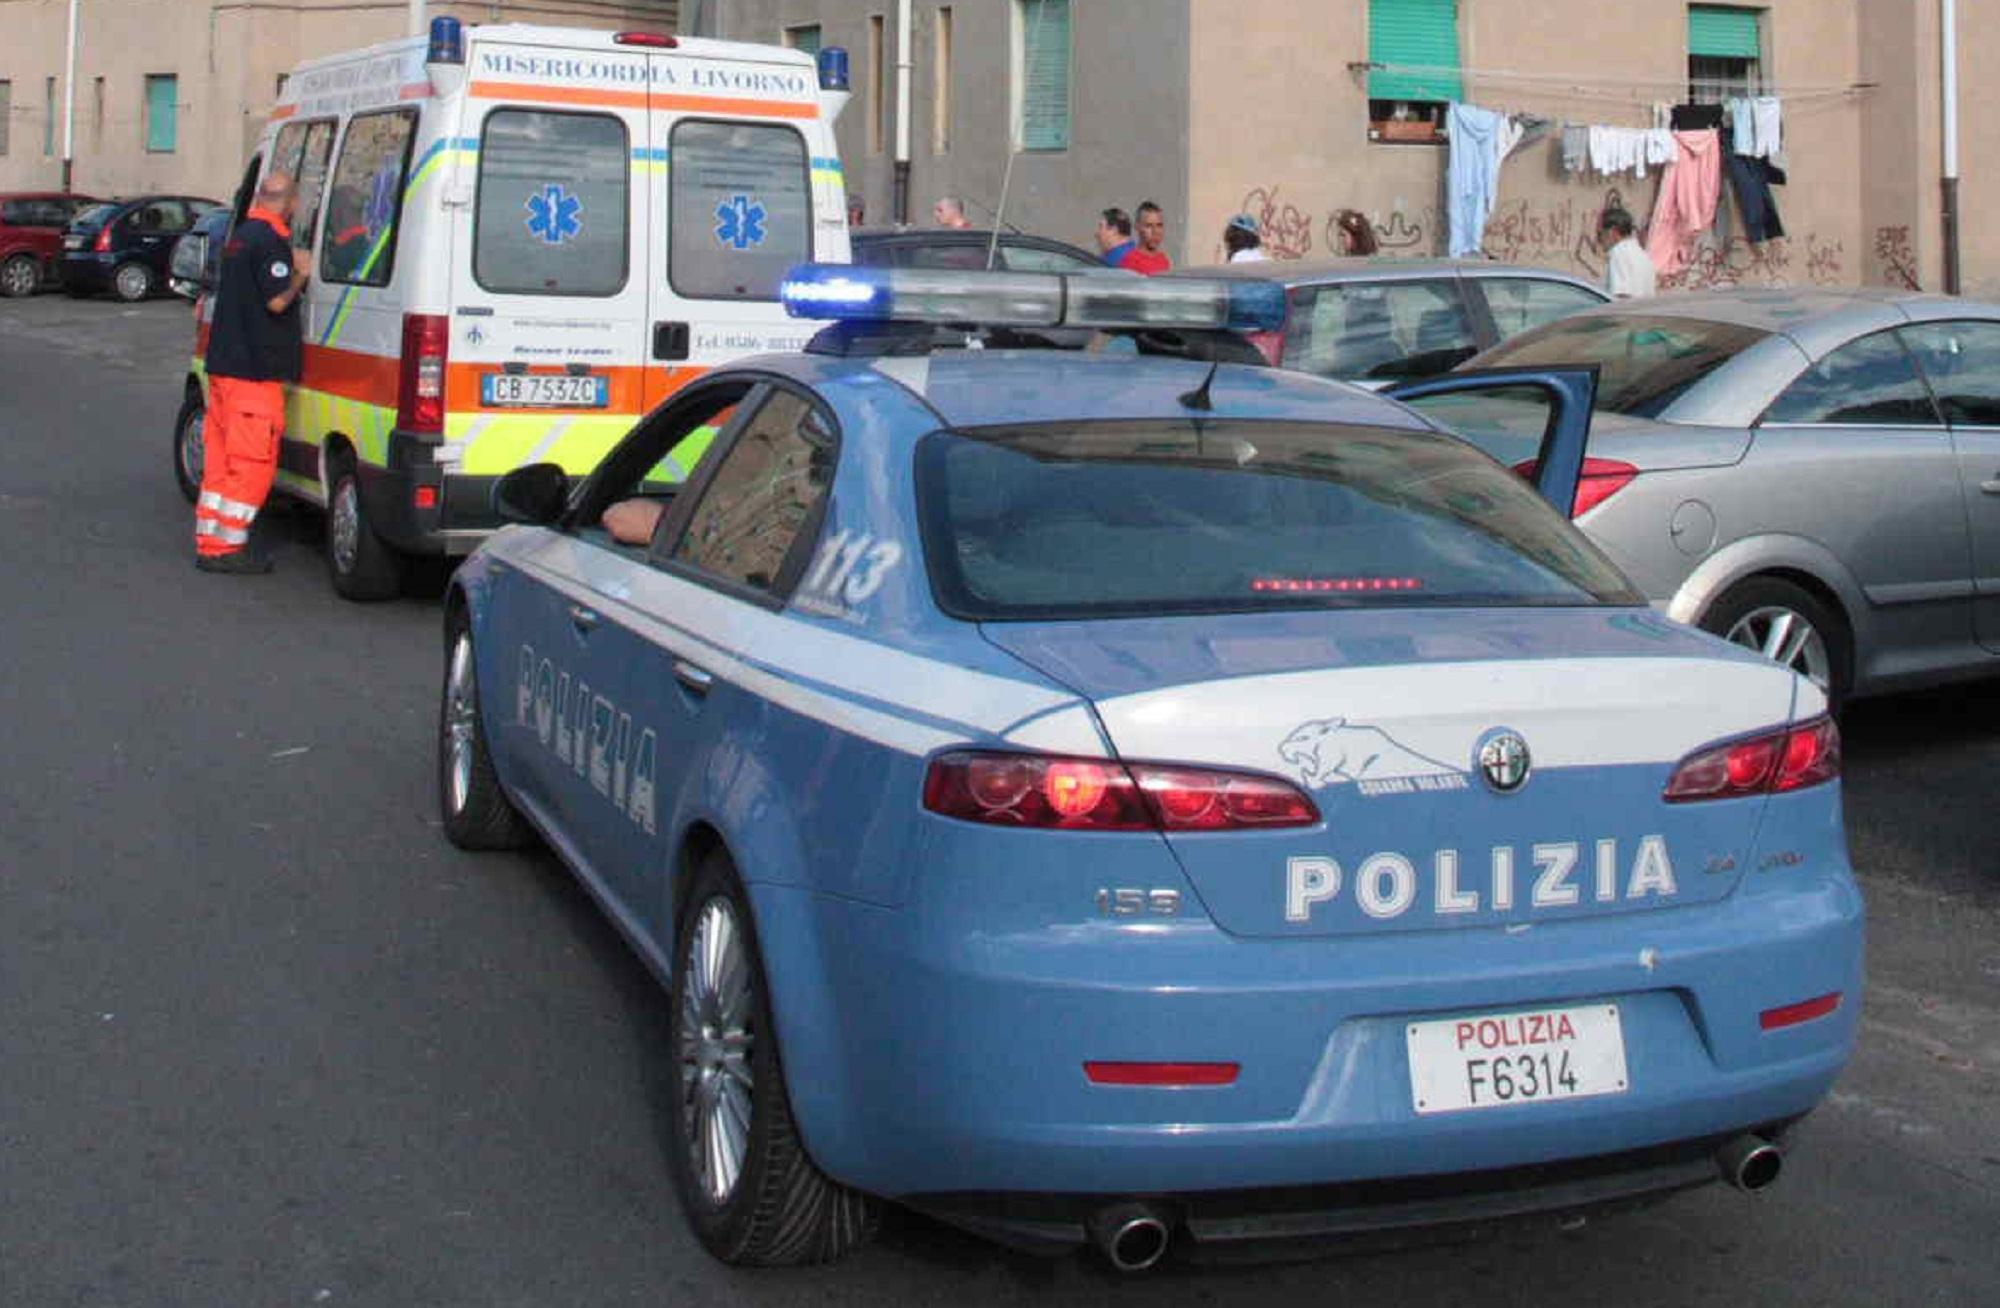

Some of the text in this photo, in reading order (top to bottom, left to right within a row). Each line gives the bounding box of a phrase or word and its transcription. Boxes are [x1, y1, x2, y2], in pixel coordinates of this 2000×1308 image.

[482, 52, 806, 93] MISERICORDIA LIVORNO
[806, 528, 901, 604] 113
[516, 643, 657, 836] POLIZIA
[1284, 834, 1678, 922] POLIZIA
[1456, 1013, 1577, 1050] POLIZIA
[1466, 1049, 1578, 1104] F6314
